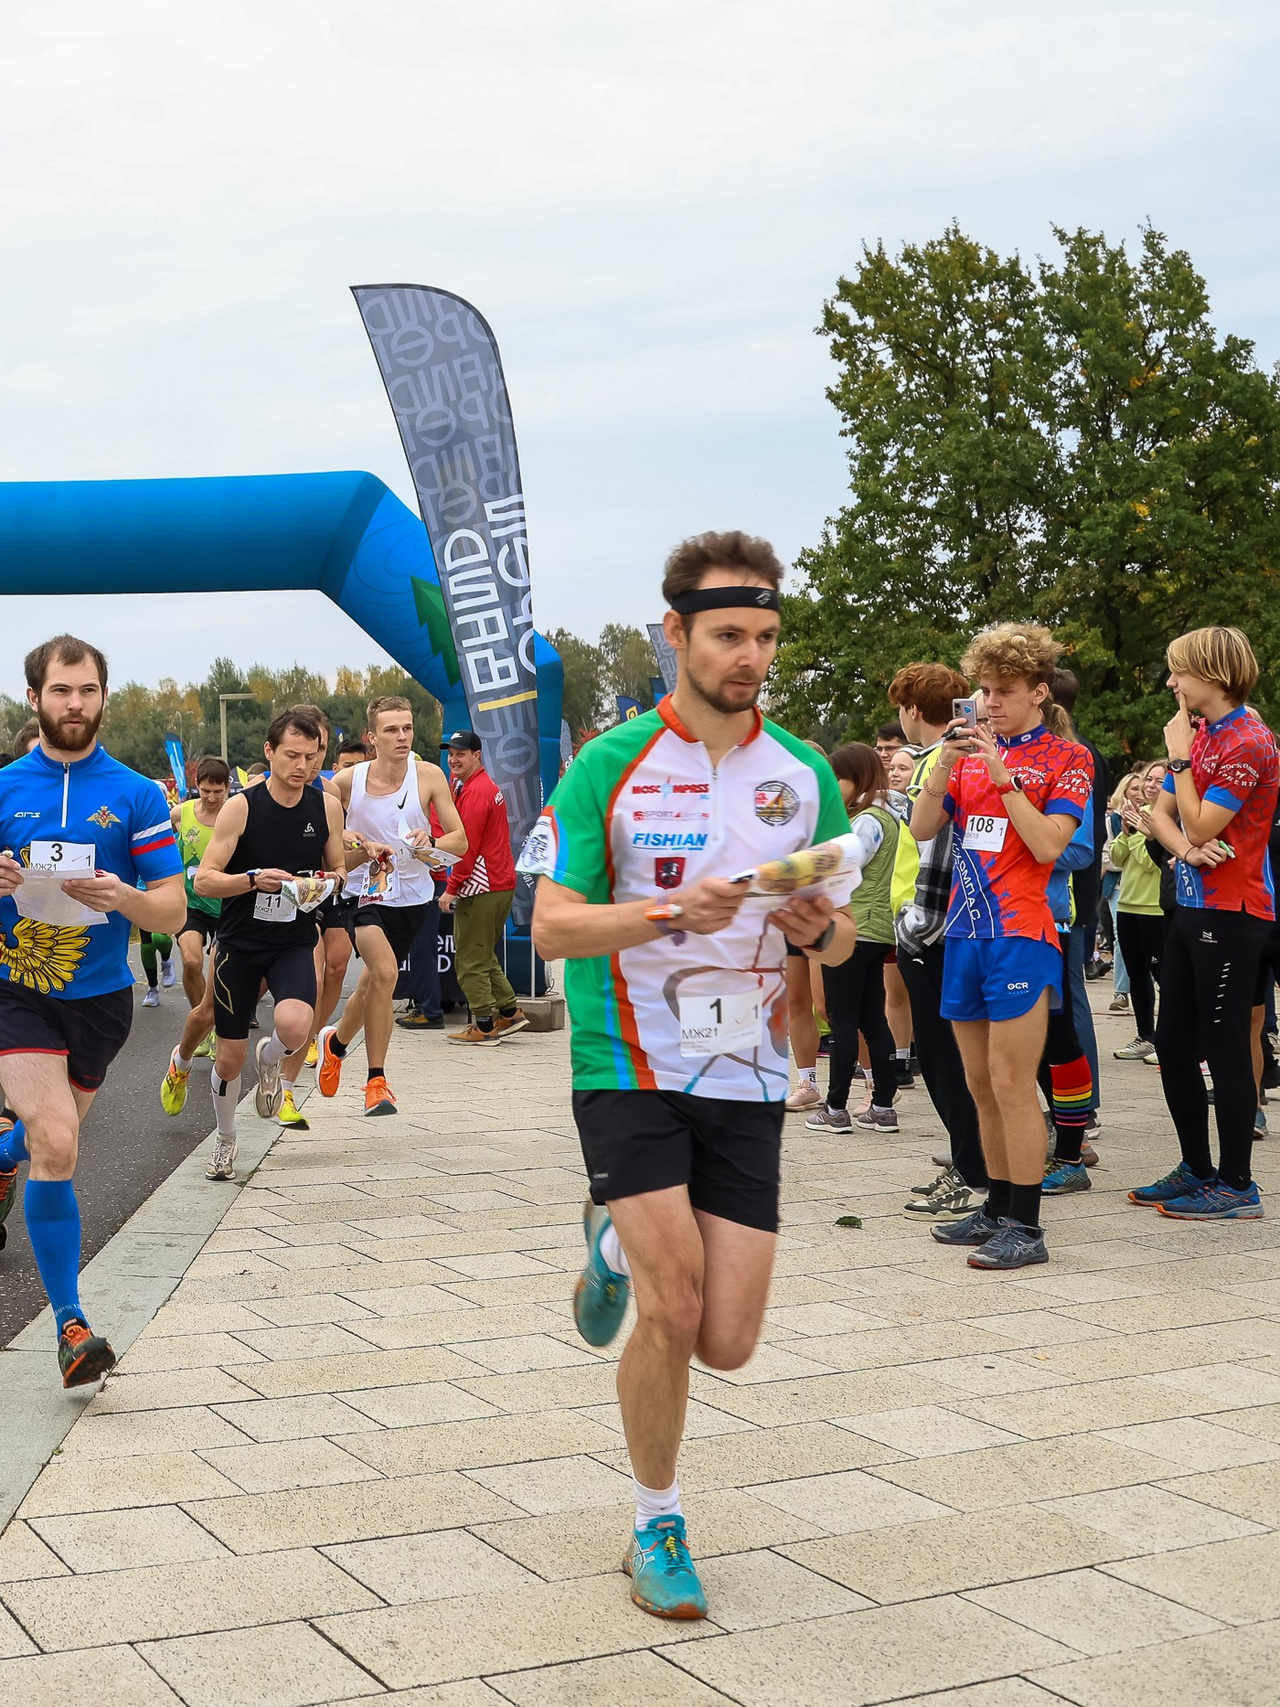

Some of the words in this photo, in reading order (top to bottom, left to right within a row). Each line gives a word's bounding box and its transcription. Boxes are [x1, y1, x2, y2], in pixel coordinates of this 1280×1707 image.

[969, 817, 995, 833] 108
[999, 827, 1004, 837] 1
[632, 832, 708, 847] FISHIAN
[50, 843, 63, 862] 3
[85, 855, 92, 867] 1
[265, 895, 282, 909] 11
[709, 997, 722, 1024] 1
[752, 1003, 758, 1020] 1
